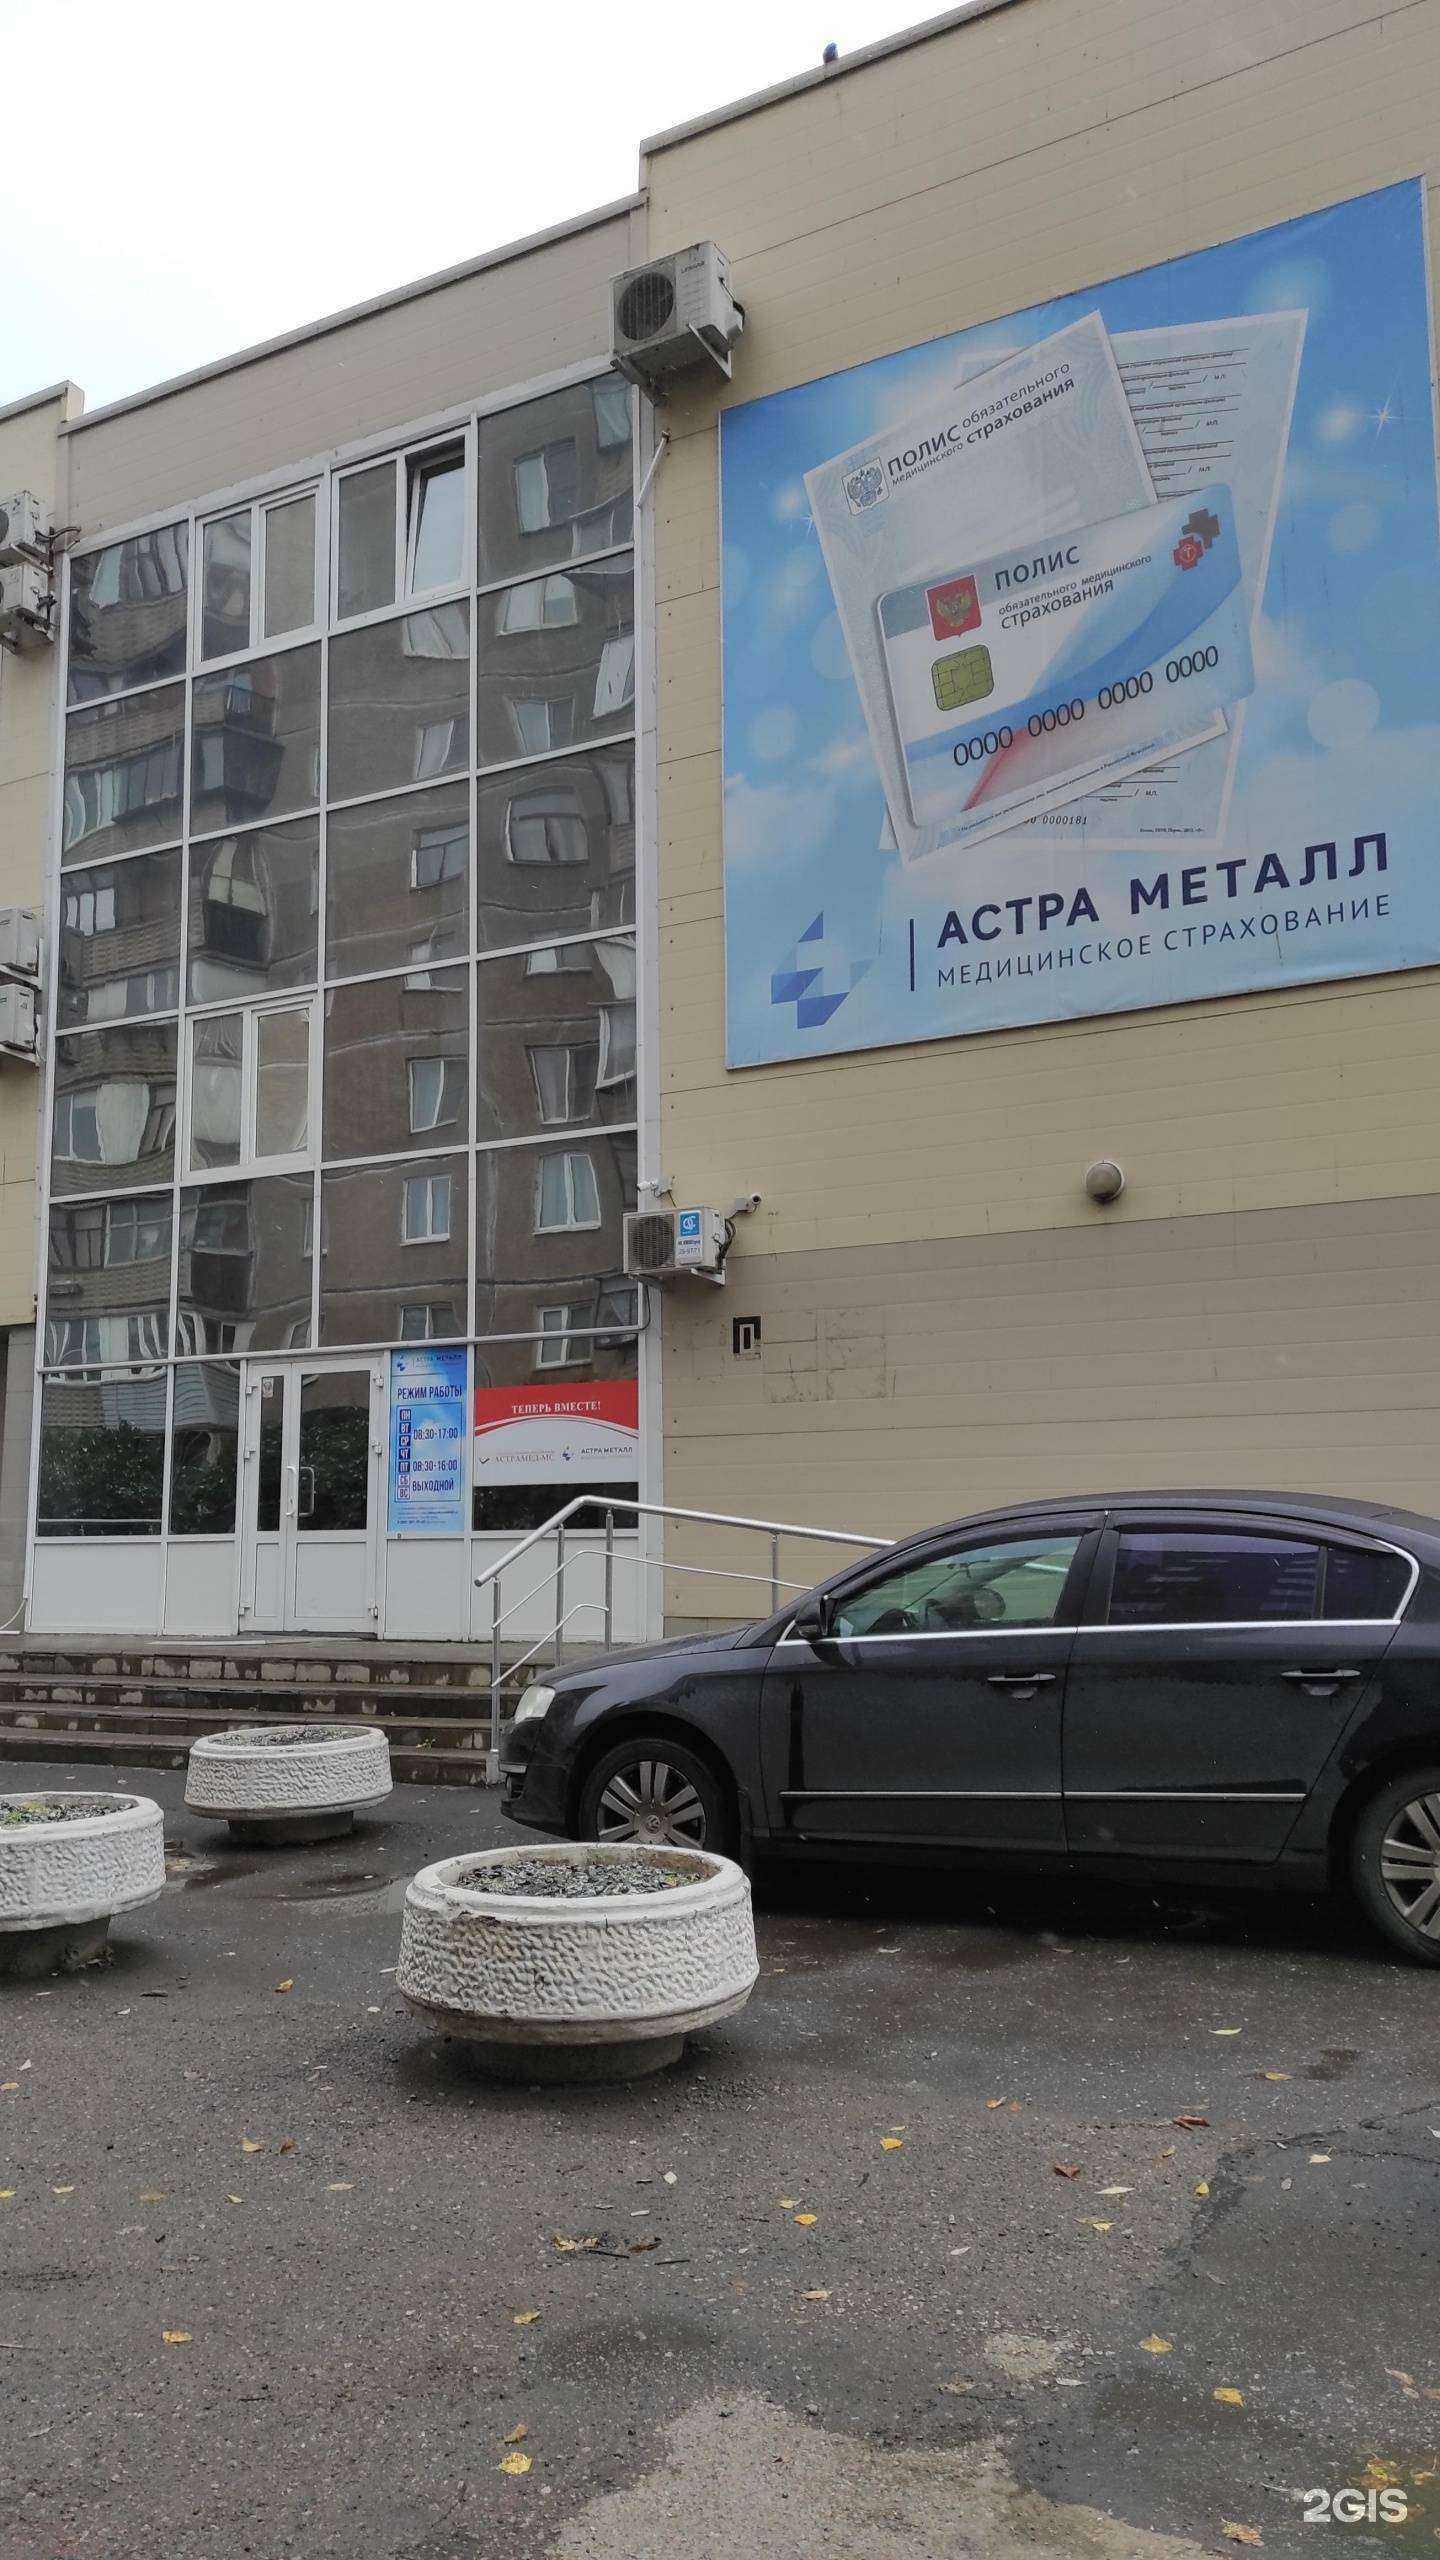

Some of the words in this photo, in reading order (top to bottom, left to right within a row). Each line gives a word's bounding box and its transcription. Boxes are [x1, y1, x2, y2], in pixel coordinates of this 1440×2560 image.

[887, 424, 961, 476] ПОЛИС
[962, 363, 1070, 429] обязательного
[891, 442, 964, 487] медицинского
[966, 378, 1075, 444] страхования
[994, 545, 1080, 591] ПОЛИС
[998, 581, 1077, 616] обязательного
[1081, 555, 1152, 585] медицинского
[1001, 579, 1114, 629] страхования
[953, 725, 1014, 766] 0000
[1027, 698, 1085, 737] 0000
[1098, 670, 1154, 710] 0000
[1165, 645, 1219, 683] 0000
[936, 887, 1100, 949] АСТРА
[1129, 832, 1389, 915] МЕТАЛЛ
[938, 935, 1152, 988] МЕДИЦИНСКОЕ
[1163, 894, 1391, 951] СТРАХОВАНИЕ
[397, 1386, 427, 1400] РЕЖИМ
[429, 1385, 462, 1398] РАБОТЫ
[511, 1403, 551, 1414] ТЕПЕРЬ
[554, 1401, 602, 1412] ВМЕСТЕ!
[401, 1410, 411, 1420] ПН
[401, 1423, 410, 1433] ВТ
[413, 1427, 459, 1440] 08:30-17:00
[400, 1436, 409, 1446] СР
[400, 1449, 409, 1459] ЧТ
[400, 1462, 409, 1471] ПТ
[412, 1459, 458, 1472] 08:30-16:00
[400, 1475, 409, 1485] СБ
[412, 1477, 454, 1492] ВЫХОДНОЙ
[399, 1488, 409, 1498] ВС
